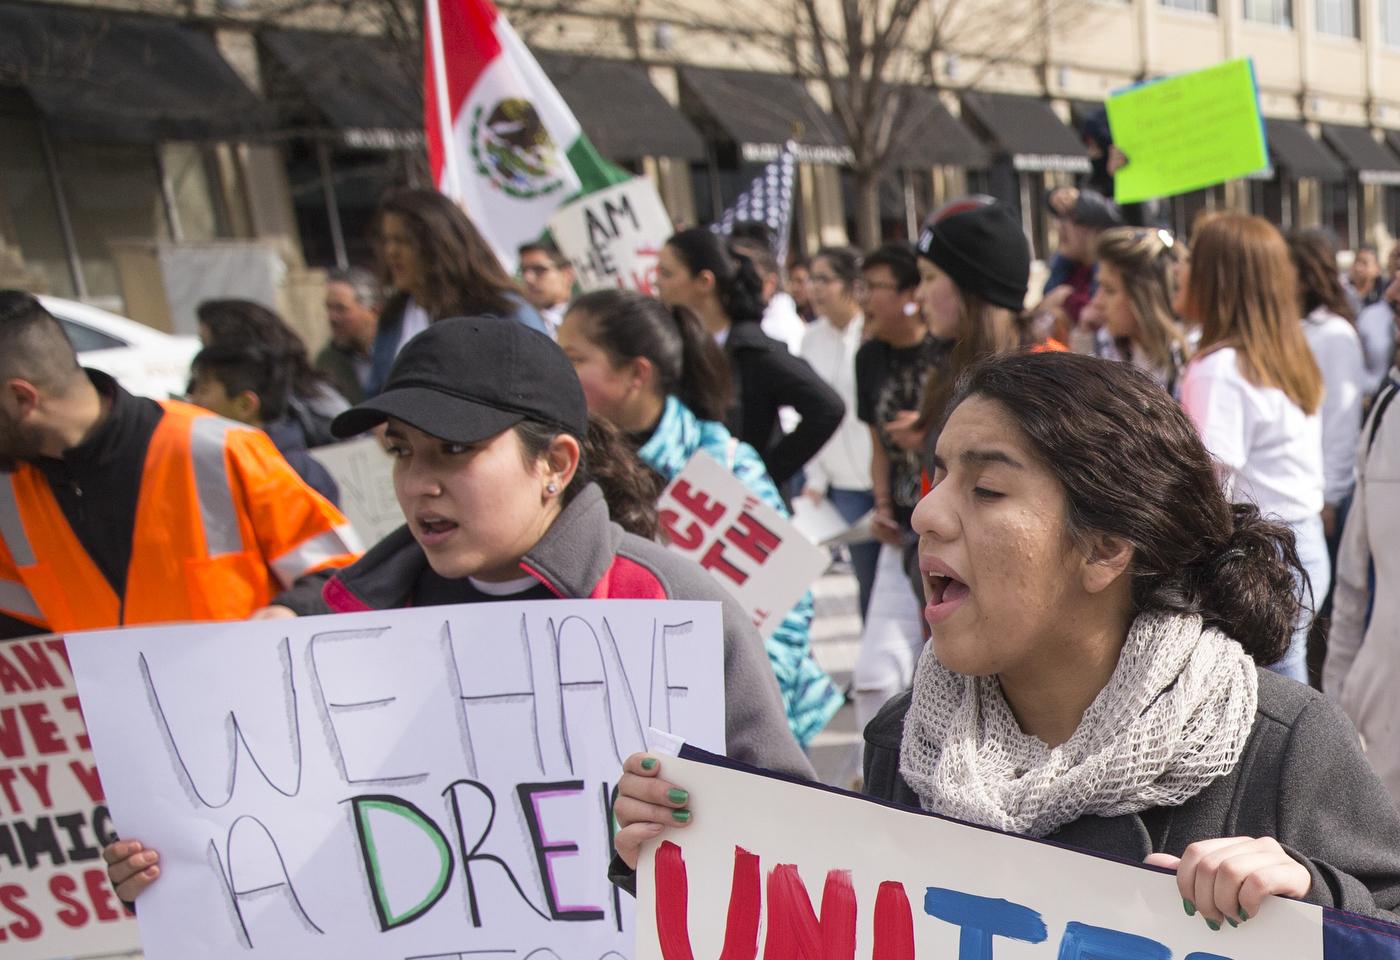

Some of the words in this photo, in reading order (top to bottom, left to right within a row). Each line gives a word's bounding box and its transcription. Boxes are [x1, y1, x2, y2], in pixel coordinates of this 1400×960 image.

[586, 195, 640, 239] AM
[138, 624, 430, 809] WE
[442, 611, 695, 780] HAVE
[50, 869, 136, 928] SE
[207, 814, 325, 949] A
[338, 779, 623, 933] DRE
